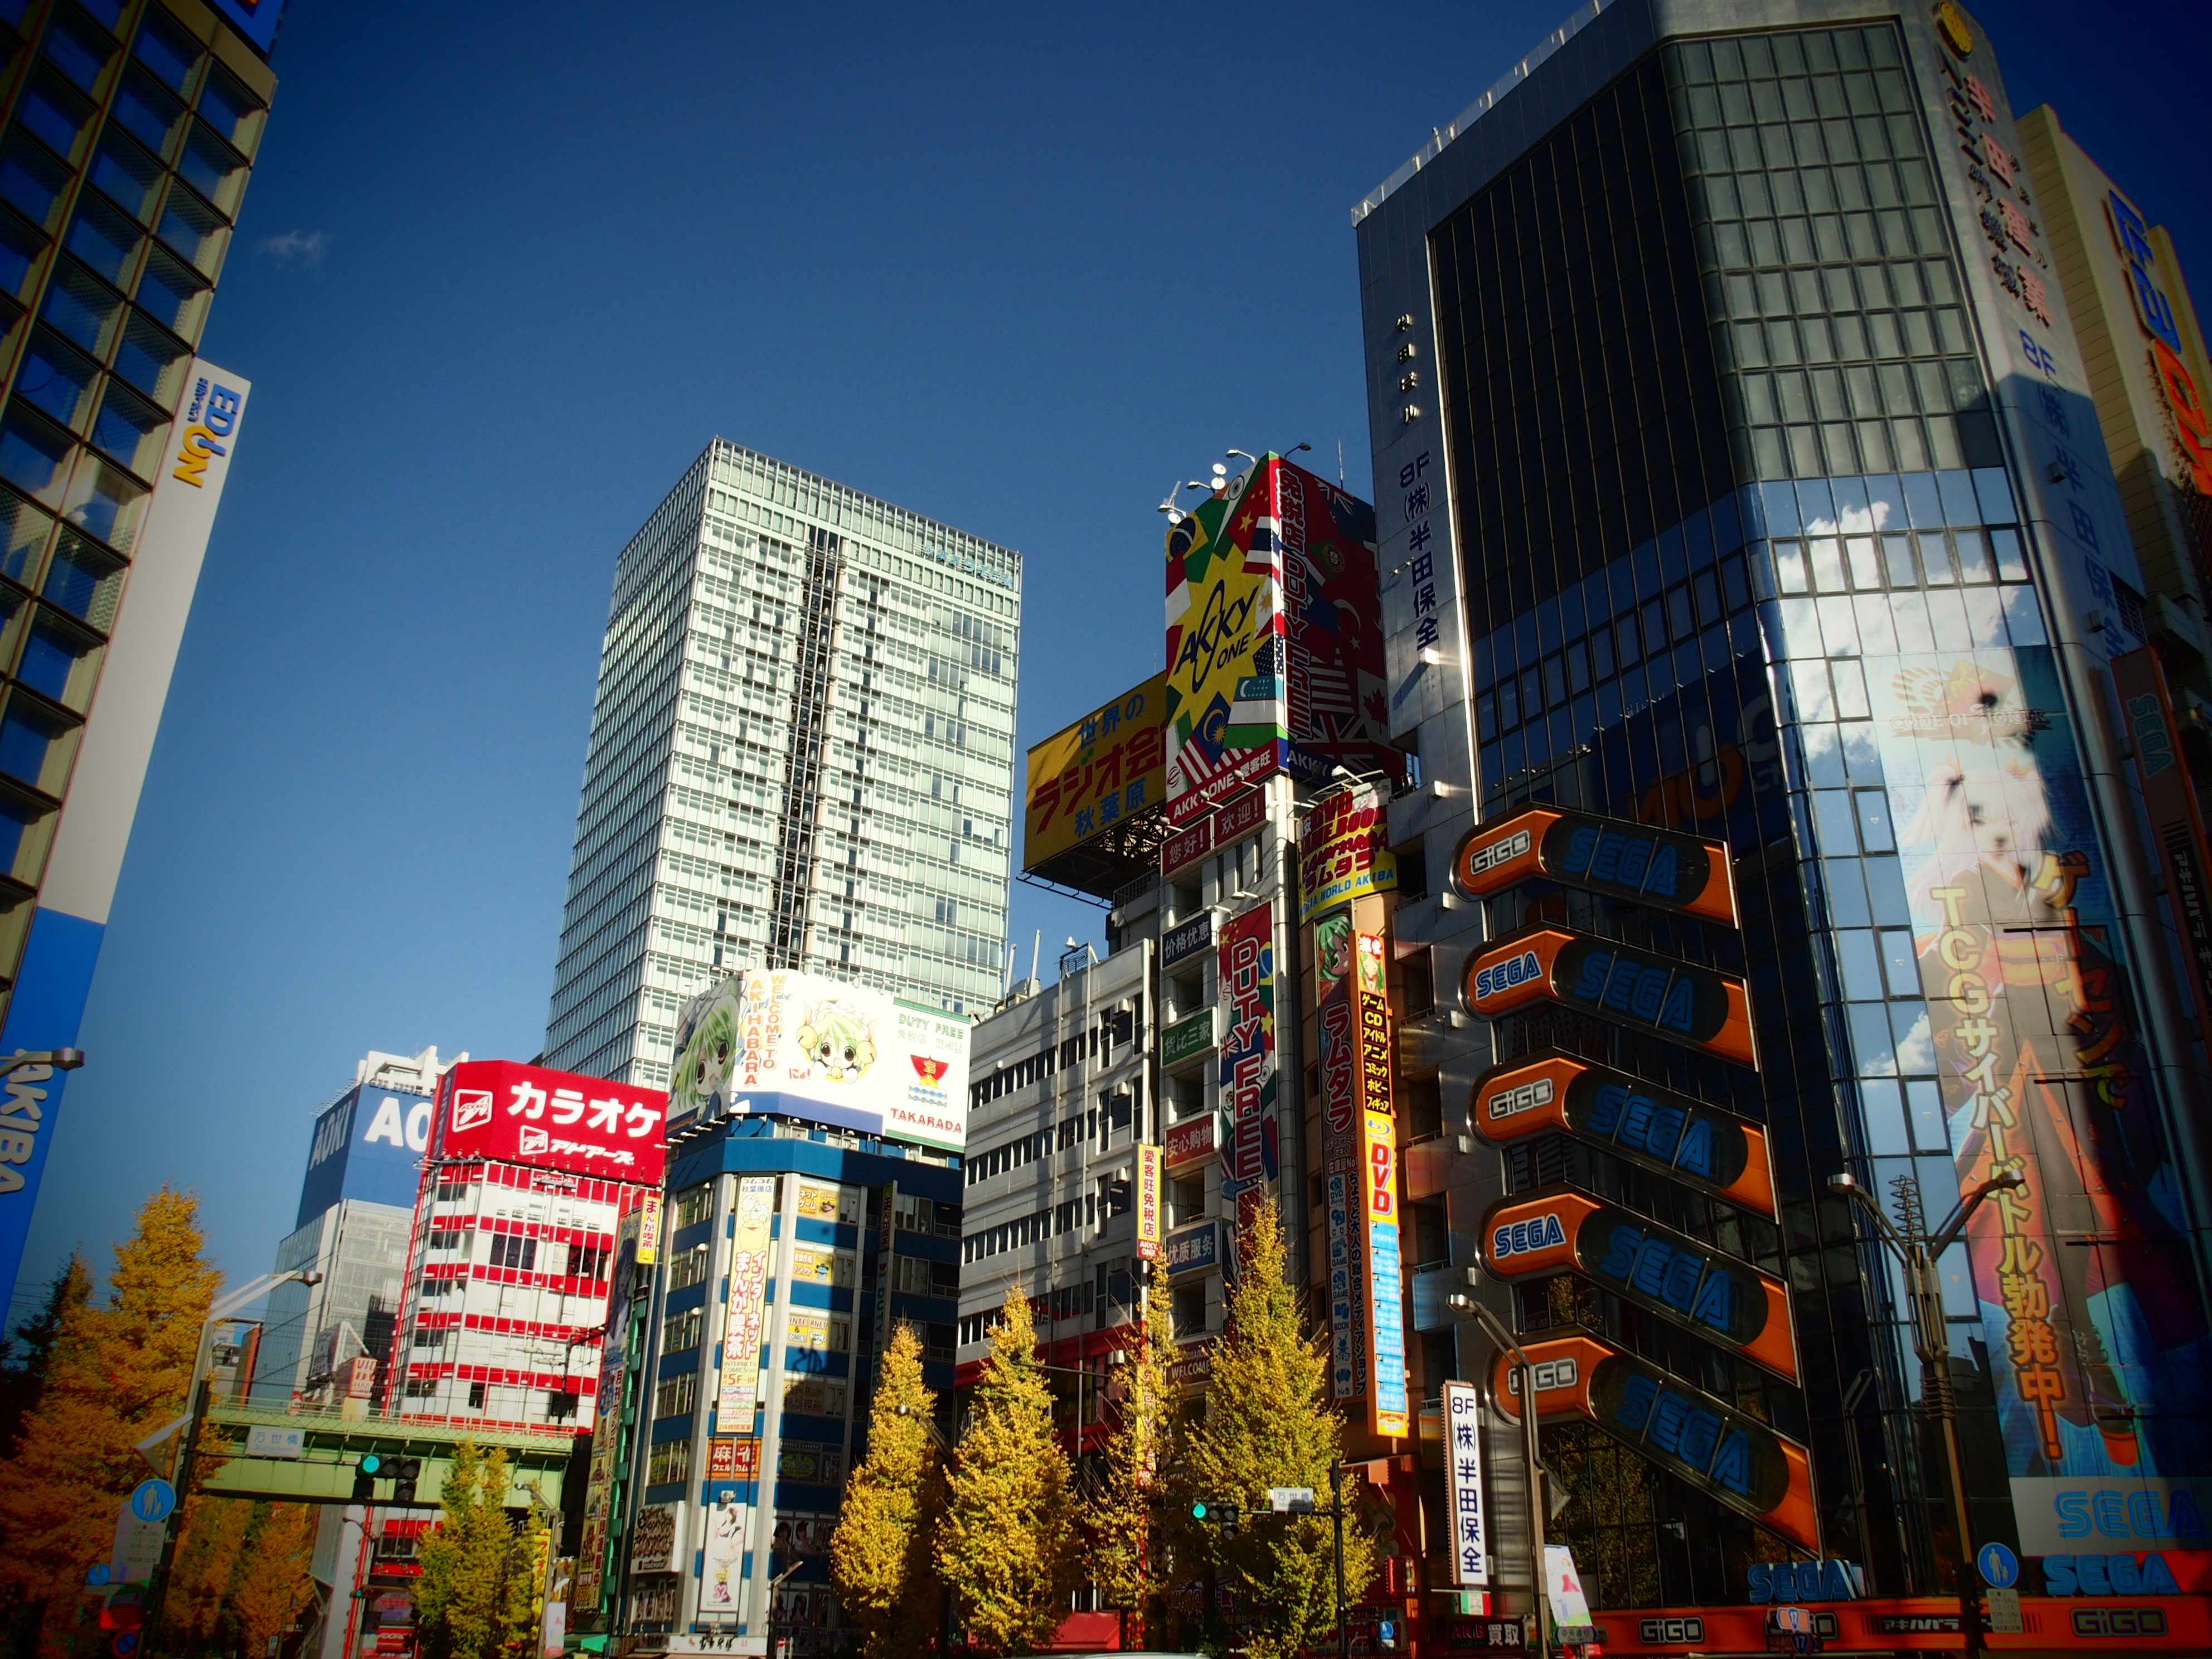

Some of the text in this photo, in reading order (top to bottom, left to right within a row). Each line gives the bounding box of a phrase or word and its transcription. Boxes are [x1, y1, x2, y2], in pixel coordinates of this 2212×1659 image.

[1399, 450, 1431, 487] 8F
[1277, 466, 1304, 555] 免税店
[1217, 632, 1251, 670] ONE
[1280, 549, 1313, 740] DUTY FREE
[1078, 694, 1144, 750] 世界の
[1890, 715, 1943, 730] CODE
[1949, 713, 1972, 726] OF
[2126, 692, 2174, 780] SEGA
[1209, 775, 1235, 798] ONE
[1074, 777, 1146, 837] 秋葉原
[1221, 797, 1258, 835] 欢迎!
[1562, 827, 1678, 897] SEGA
[1321, 879, 1351, 901] WORLD
[1355, 868, 1393, 887] AKIBA
[2173, 850, 2208, 939] アキハバラ
[1165, 920, 1210, 959] 价格优惠
[1474, 951, 1542, 1001] SEGA
[1575, 952, 1694, 1033] SEGA
[1231, 937, 1260, 1052] DUTY
[1362, 993, 1384, 1011] ゲーム
[744, 979, 763, 1085] AKIHABARA
[763, 975, 785, 1069] WELCOME TO
[899, 1013, 964, 1039] DUTY FREE
[1363, 1027, 1386, 1044] アイドル
[1364, 1011, 1383, 1027] CD
[1164, 1020, 1211, 1057] 货比三家
[1364, 1044, 1388, 1060] アニメ
[789, 1068, 811, 1080] にょ!
[1323, 1001, 1355, 1134] ラムタラ
[1365, 1062, 1388, 1078] コミック
[1366, 1079, 1388, 1093] ホビー
[507, 1081, 661, 1137] カラオケ
[890, 1108, 962, 1134] TAKARADA
[1234, 1056, 1263, 1182] FREE
[1366, 1096, 1390, 1113] フィギュア
[1167, 1123, 1212, 1158] 安心购物
[1588, 1084, 1711, 1178] SEGA
[549, 1138, 634, 1166] アドアーズ
[799, 1189, 817, 1199] ネット
[1330, 1190, 1343, 1199] DVD
[1371, 1142, 1393, 1216] DVD
[798, 1199, 817, 1210] ゲーム
[641, 1200, 658, 1250] まんが喫茶
[1494, 1212, 1567, 1260] SEGA
[1168, 1234, 1214, 1265] 优质服务
[1332, 1257, 1347, 1267] GAME
[1332, 1289, 1348, 1299] GAME
[1333, 1283, 1342, 1291] PC
[1600, 1225, 1730, 1331] SEGA
[726, 1250, 751, 1360] まんが喫茶
[745, 1250, 766, 1360] インターネット
[810, 1320, 827, 1329] RNET
[1334, 1321, 1349, 1331] BOOK
[1171, 1360, 1211, 1379] WELCOME
[1376, 1354, 1383, 1362] 1F
[1338, 1386, 1350, 1396] トレカ
[1452, 1396, 1474, 1415] 8F
[254, 1432, 298, 1445] 万世橋
[1615, 1375, 1748, 1496] SEGA
[2054, 1490, 2212, 1539] SEGA
[1748, 1560, 1854, 1604] SEGA
[2043, 1553, 2182, 1596] SEGA
[1488, 1623, 1520, 1646] 買取
[1794, 1635, 1805, 1648] 17
[1883, 1618, 1960, 1630] アキハバラ
